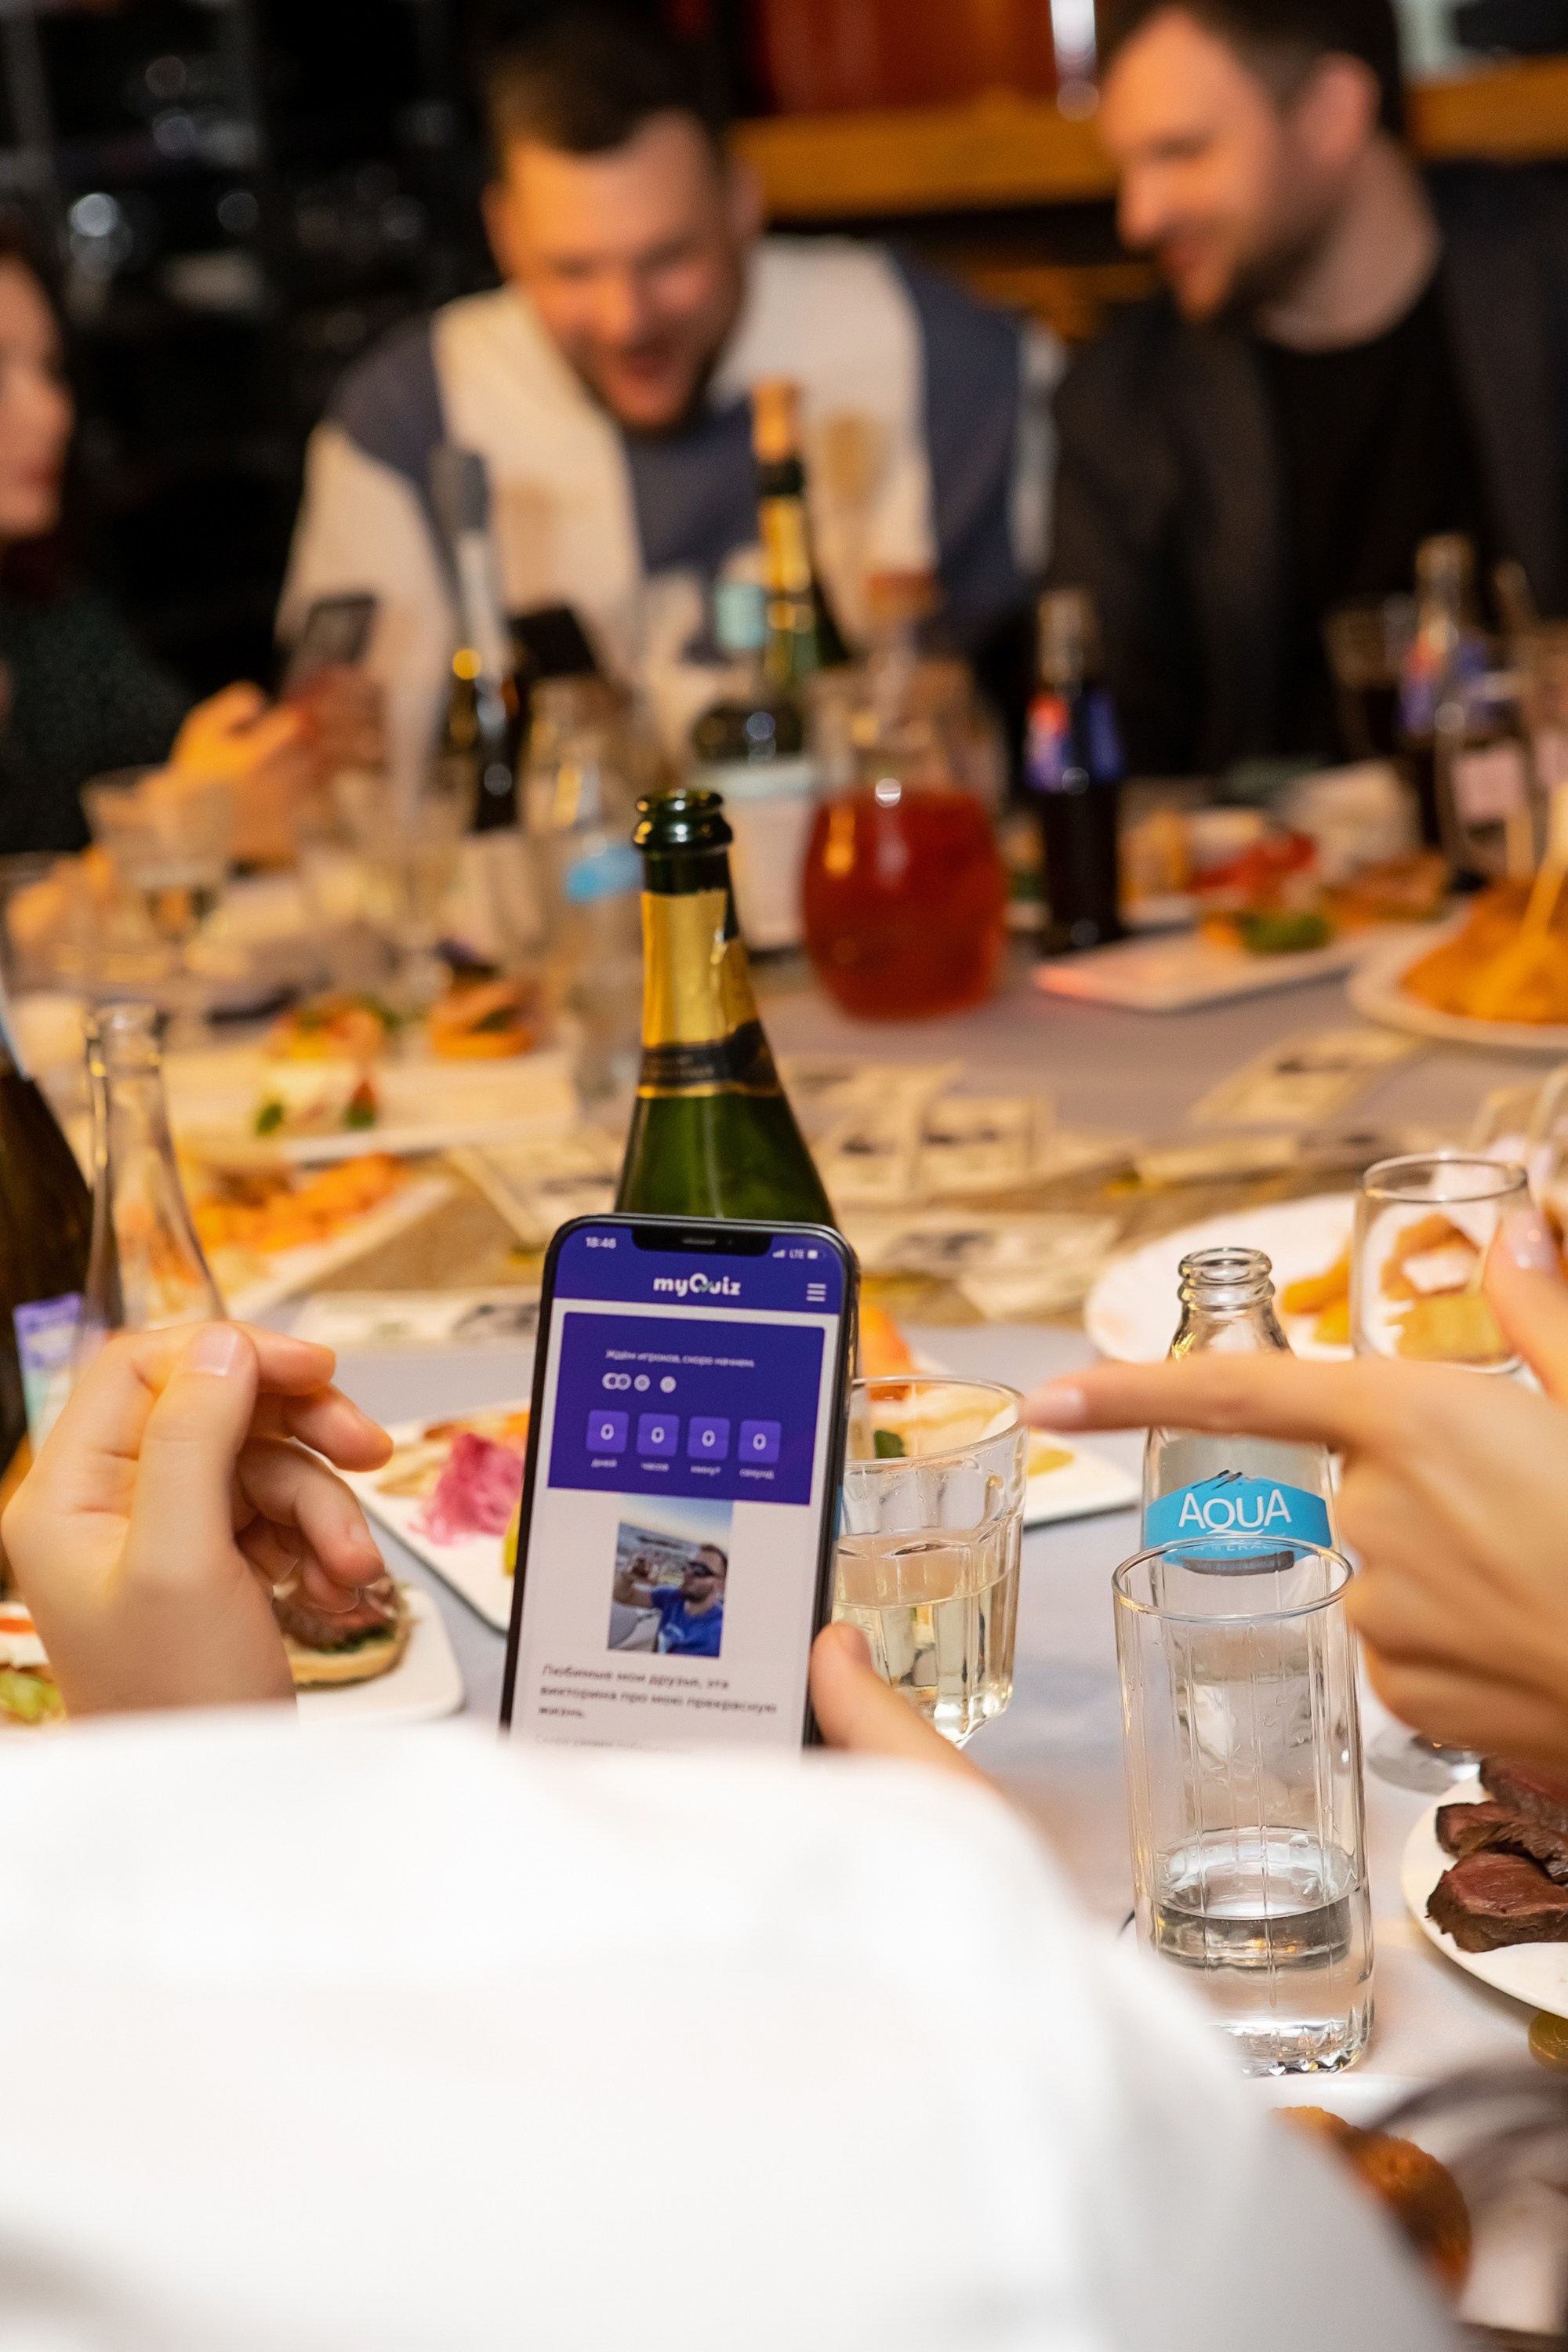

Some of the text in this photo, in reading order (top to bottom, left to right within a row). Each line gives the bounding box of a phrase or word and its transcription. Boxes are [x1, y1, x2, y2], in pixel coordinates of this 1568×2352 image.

[653, 1272, 741, 1297] myQuiz
[600, 1423, 615, 1440] 0
[651, 1426, 665, 1443] 0
[701, 1429, 716, 1447] 0
[753, 1432, 767, 1450] 0
[1178, 1489, 1291, 1535] AQUA
